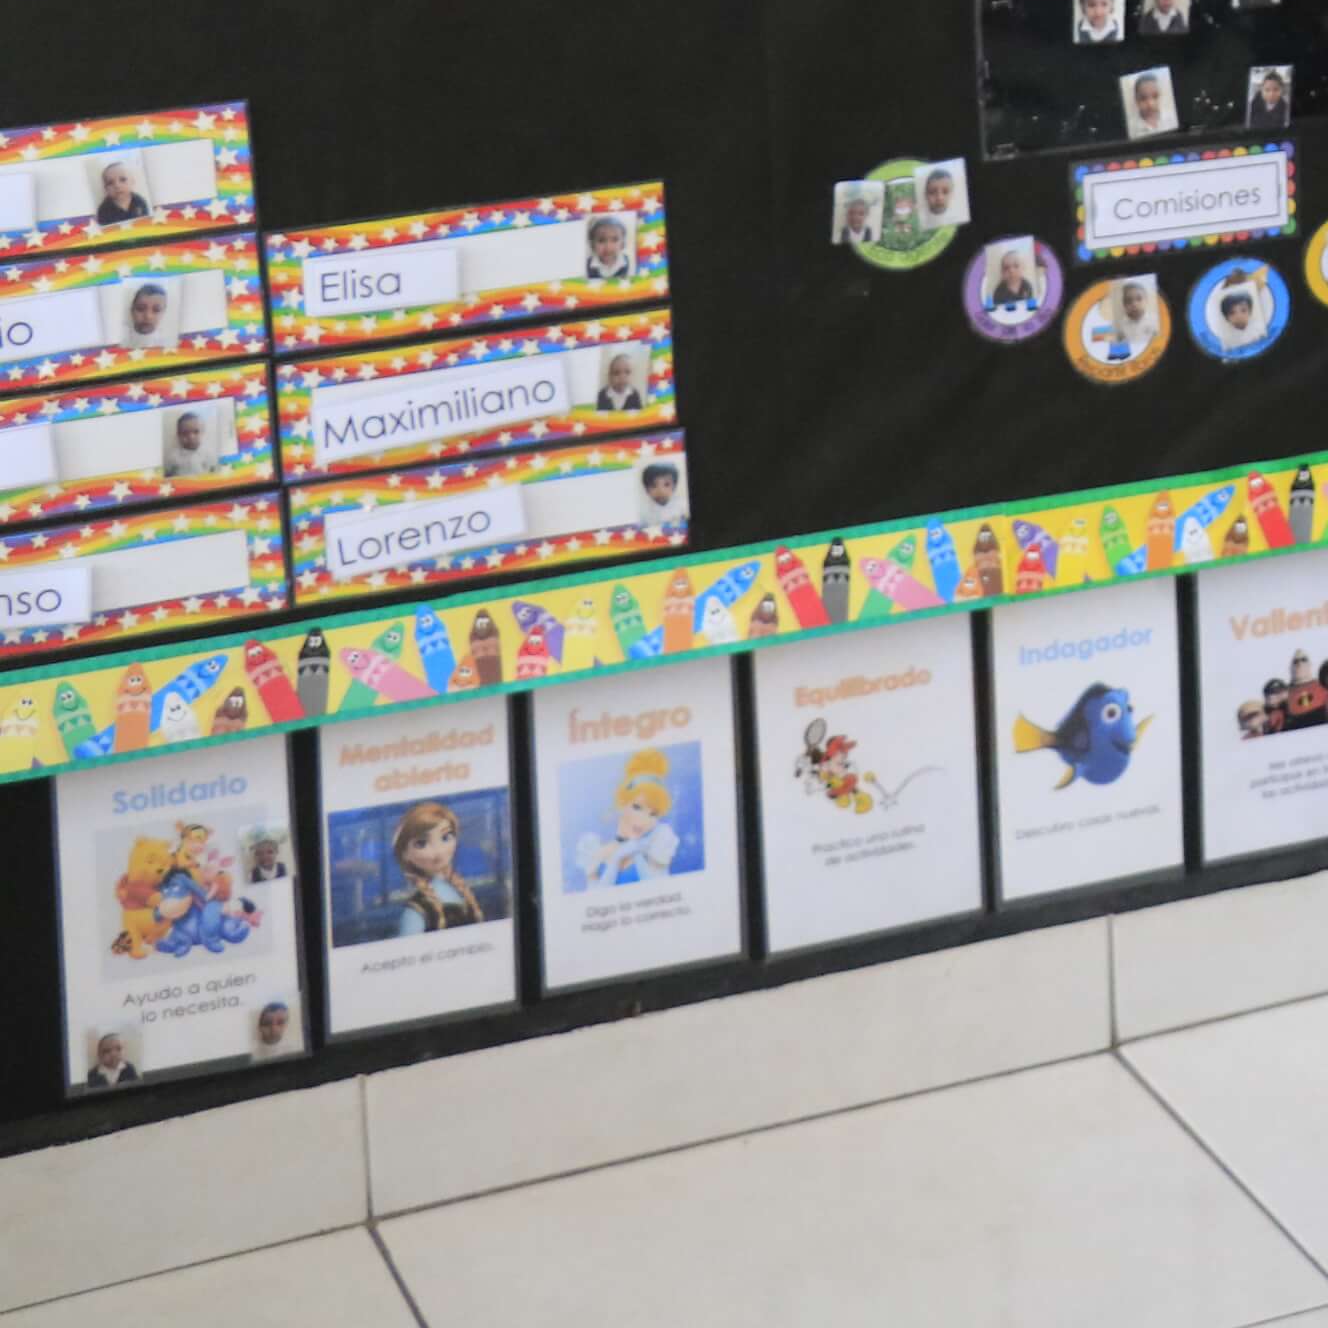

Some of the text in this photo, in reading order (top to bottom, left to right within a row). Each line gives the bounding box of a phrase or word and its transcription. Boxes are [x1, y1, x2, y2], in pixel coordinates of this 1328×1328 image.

[1112, 184, 1262, 222] Comisiones
[319, 270, 403, 302] Elisa
[322, 375, 558, 449] Maximiliano
[336, 509, 492, 567] Lorenzo
[1018, 624, 1153, 667] Indagador
[794, 665, 932, 710] Equilibrado
[339, 722, 496, 767] Mentalidad
[112, 773, 248, 814] Solidario
[374, 761, 471, 794] abierta
[122, 973, 258, 1008] Ayudo a quien
[141, 1008, 158, 1024] lo
